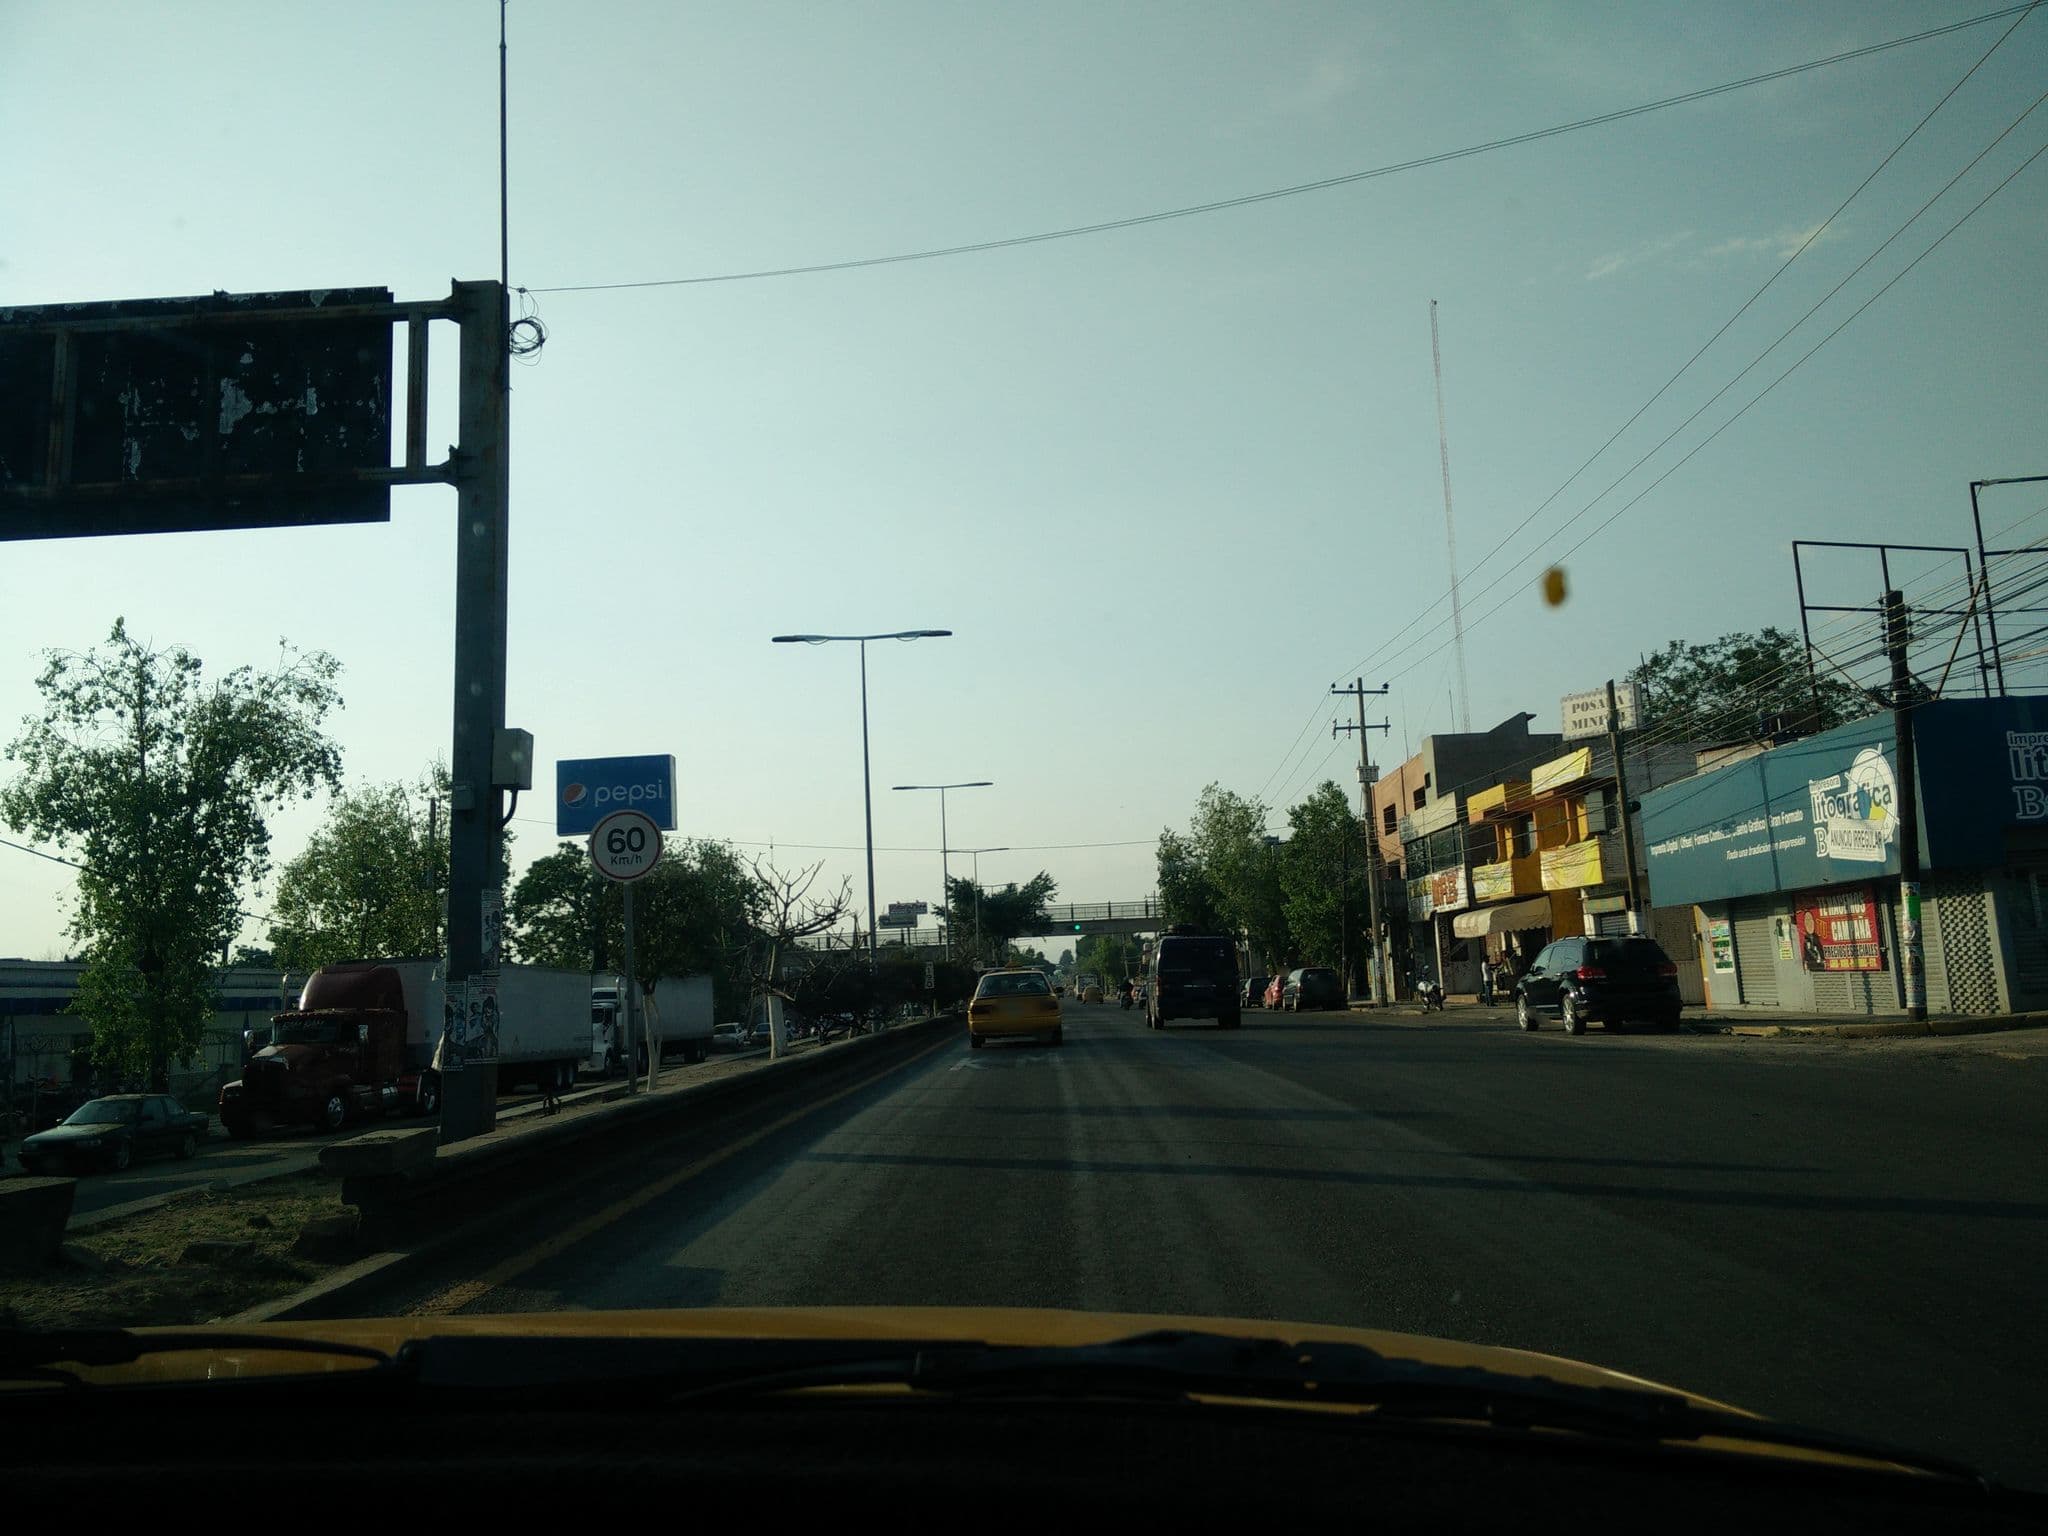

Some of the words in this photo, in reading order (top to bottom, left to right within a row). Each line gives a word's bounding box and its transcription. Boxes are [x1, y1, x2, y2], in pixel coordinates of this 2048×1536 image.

[595, 779, 663, 807] pepsi
[607, 827, 645, 854] 60
[611, 855, 642, 866] Km/h
